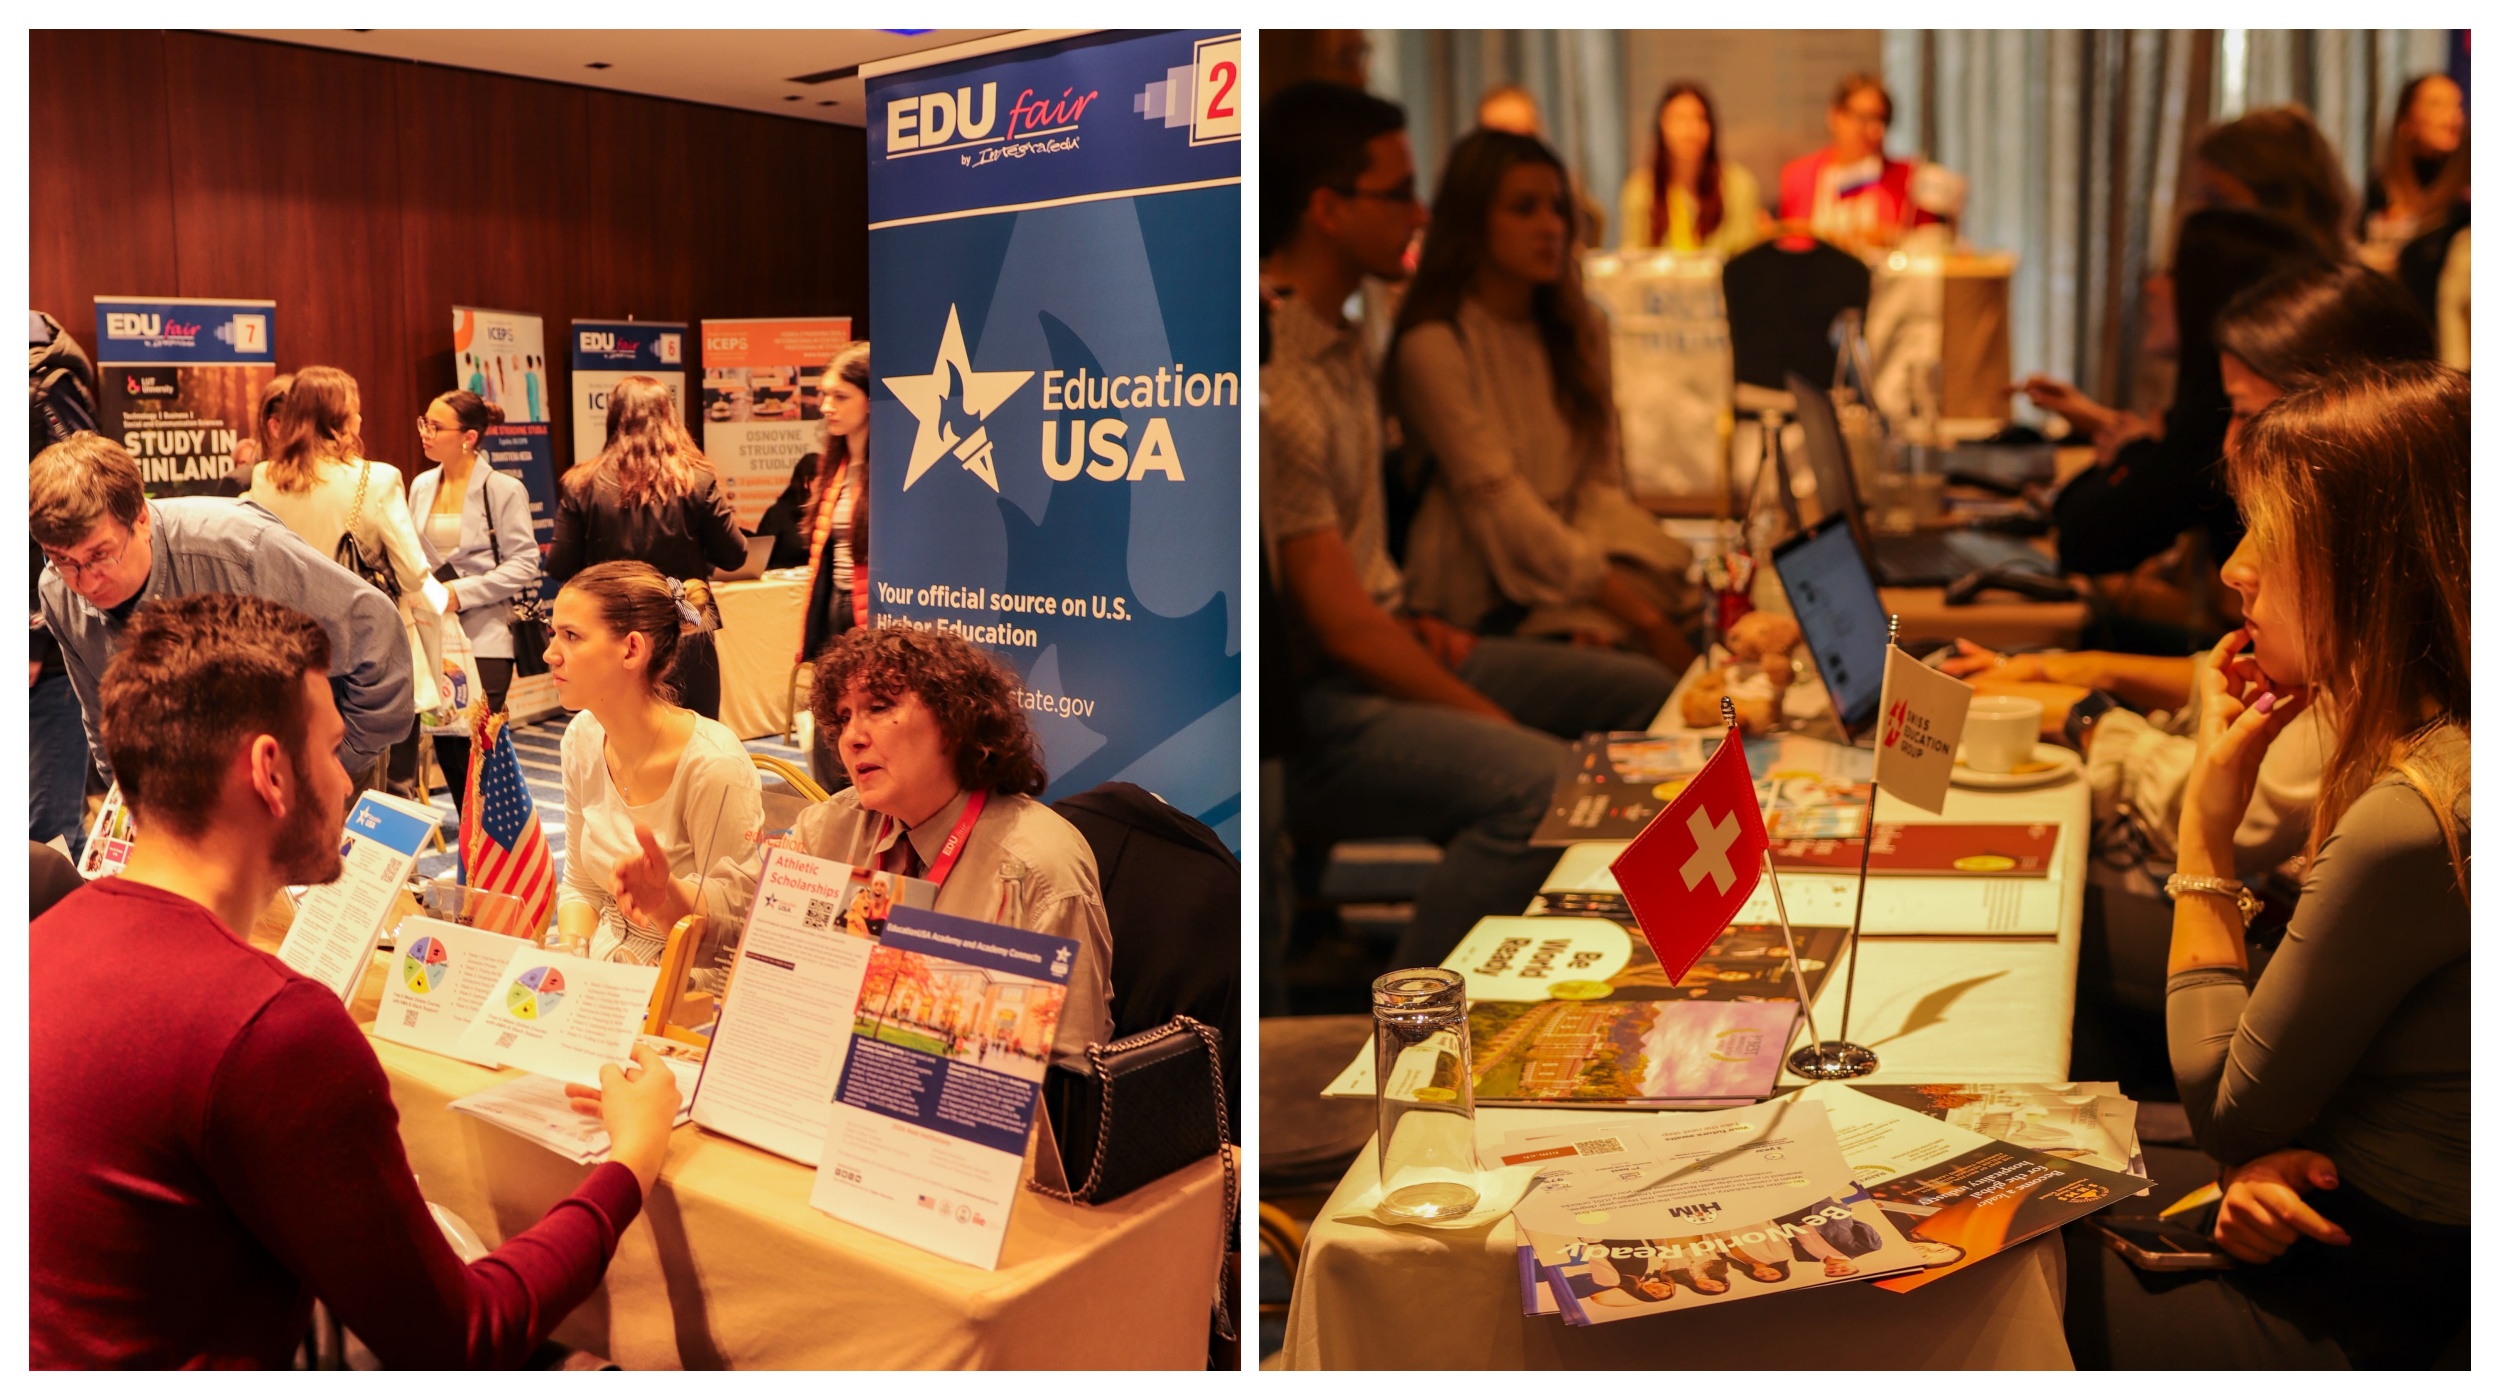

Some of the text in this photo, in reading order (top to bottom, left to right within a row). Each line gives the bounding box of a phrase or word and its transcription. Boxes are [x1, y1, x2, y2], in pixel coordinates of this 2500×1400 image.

[1206, 61, 1238, 120] 2
[886, 82, 1098, 153] EDU fair
[961, 155, 971, 167] by
[107, 313, 201, 338] EDU fair
[245, 324, 256, 344] 7
[487, 327, 513, 342] ICEPS
[580, 332, 615, 351] EDU
[668, 341, 675, 356] 6
[707, 338, 748, 351] ICEPS
[141, 377, 155, 385] LUT
[141, 385, 174, 395] University
[1043, 363, 1239, 410] Education
[123, 411, 189, 420] Technology Business
[155, 420, 197, 428] Communication
[124, 429, 237, 456] STUDY IN
[746, 429, 802, 442] OSNOVNE
[739, 443, 809, 456] STRUKOVNE
[1042, 417, 1186, 482] USA
[877, 582, 1132, 621] Your official source on U.S.
[937, 618, 1037, 647] Education
[1907, 710, 1931, 731] SWISS
[1901, 740, 1924, 759] GROUP
[1903, 725, 1951, 755] EDUCATION
[942, 835, 959, 857] EDU
[775, 856, 820, 875] Athletic
[770, 872, 840, 899] Scholarships
[886, 922, 1042, 964] EducationUSA Academy and Academy Connects
[1473, 937, 1532, 977] Ready
[1517, 937, 1573, 979] World
[1566, 951, 1604, 971] Be
[1967, 1160, 2035, 1189] hospitality
[1970, 1165, 2048, 1199] for the global
[2015, 1169, 2066, 1191] Become
[1918, 1185, 1972, 1206] industry
[1976, 1192, 2010, 1208] leader
[1668, 1202, 1722, 1218] HIM
[1556, 1205, 1853, 1260] Be World Ready
